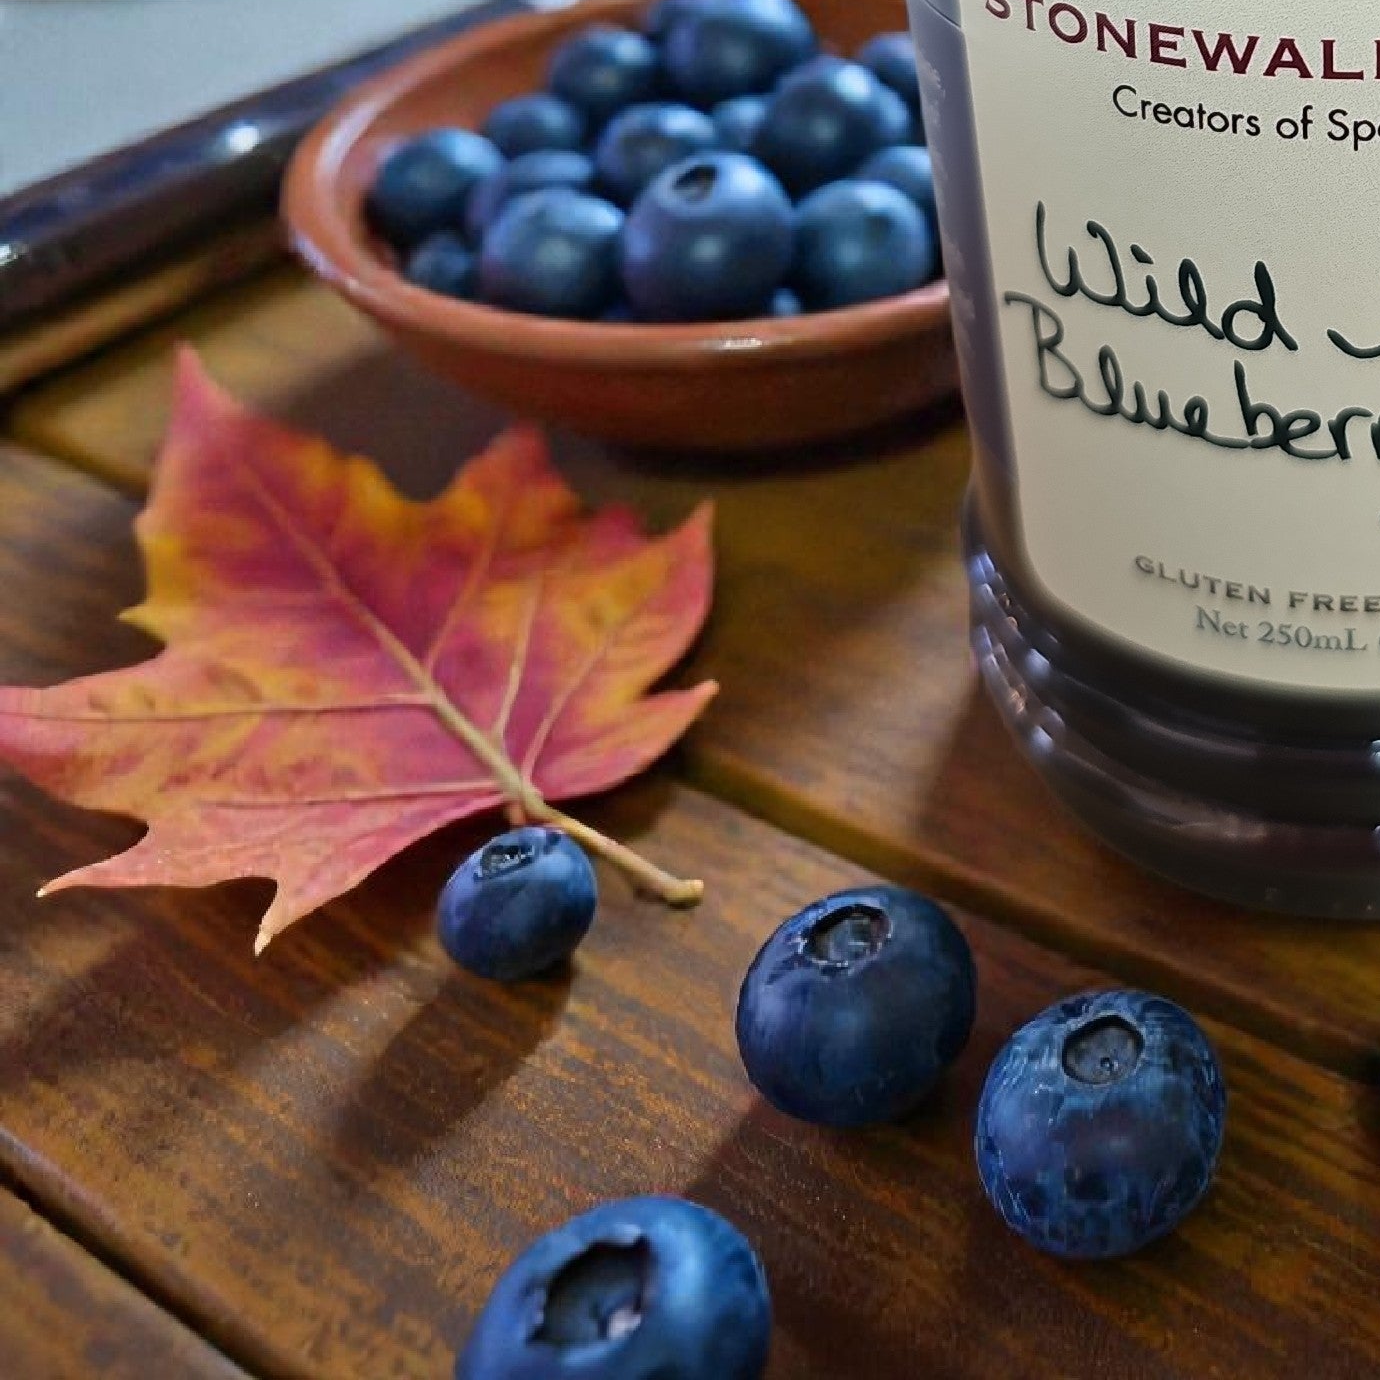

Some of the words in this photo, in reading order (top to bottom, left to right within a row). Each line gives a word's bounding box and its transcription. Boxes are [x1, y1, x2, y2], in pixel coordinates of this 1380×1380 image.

[1113, 85, 1262, 139] Creators
[1275, 105, 1314, 140] of
[1036, 200, 1298, 352] Wild
[1134, 555, 1271, 605] GLUTEN
[1194, 605, 1249, 640] Net
[1256, 621, 1368, 653] 250mL
